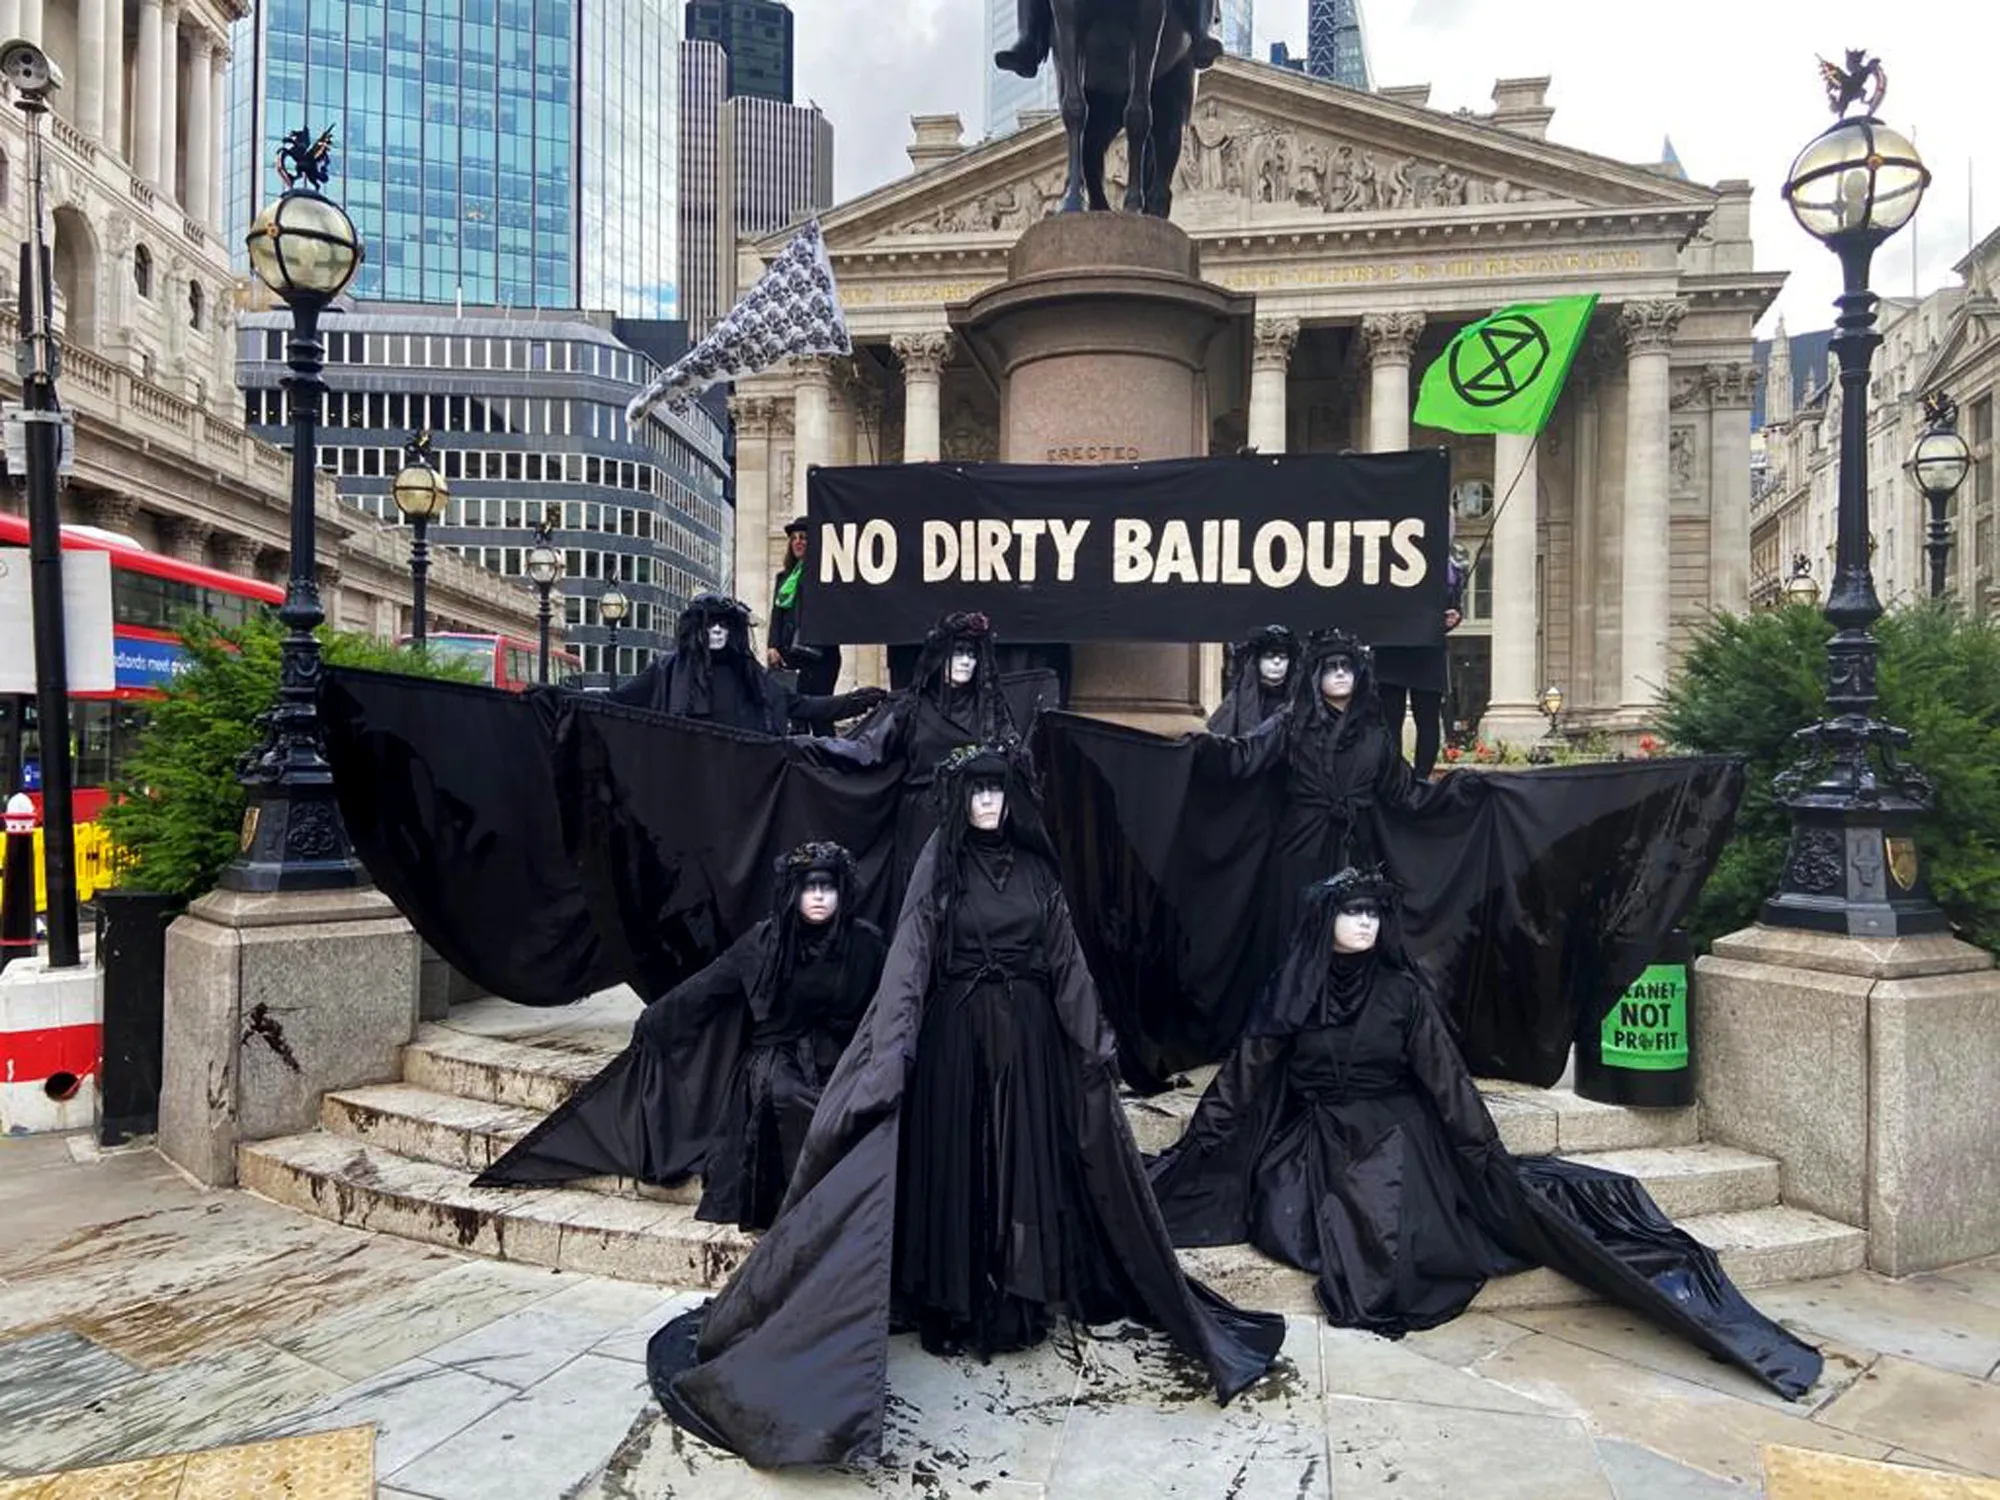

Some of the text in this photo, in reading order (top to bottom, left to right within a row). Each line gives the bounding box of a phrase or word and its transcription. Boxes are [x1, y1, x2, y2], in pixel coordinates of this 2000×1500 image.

[1046, 445, 1140, 462] ERECTED
[819, 517, 1427, 588] NO DIRTY BAILOUTS
[1620, 1001, 1671, 1029] NOT
